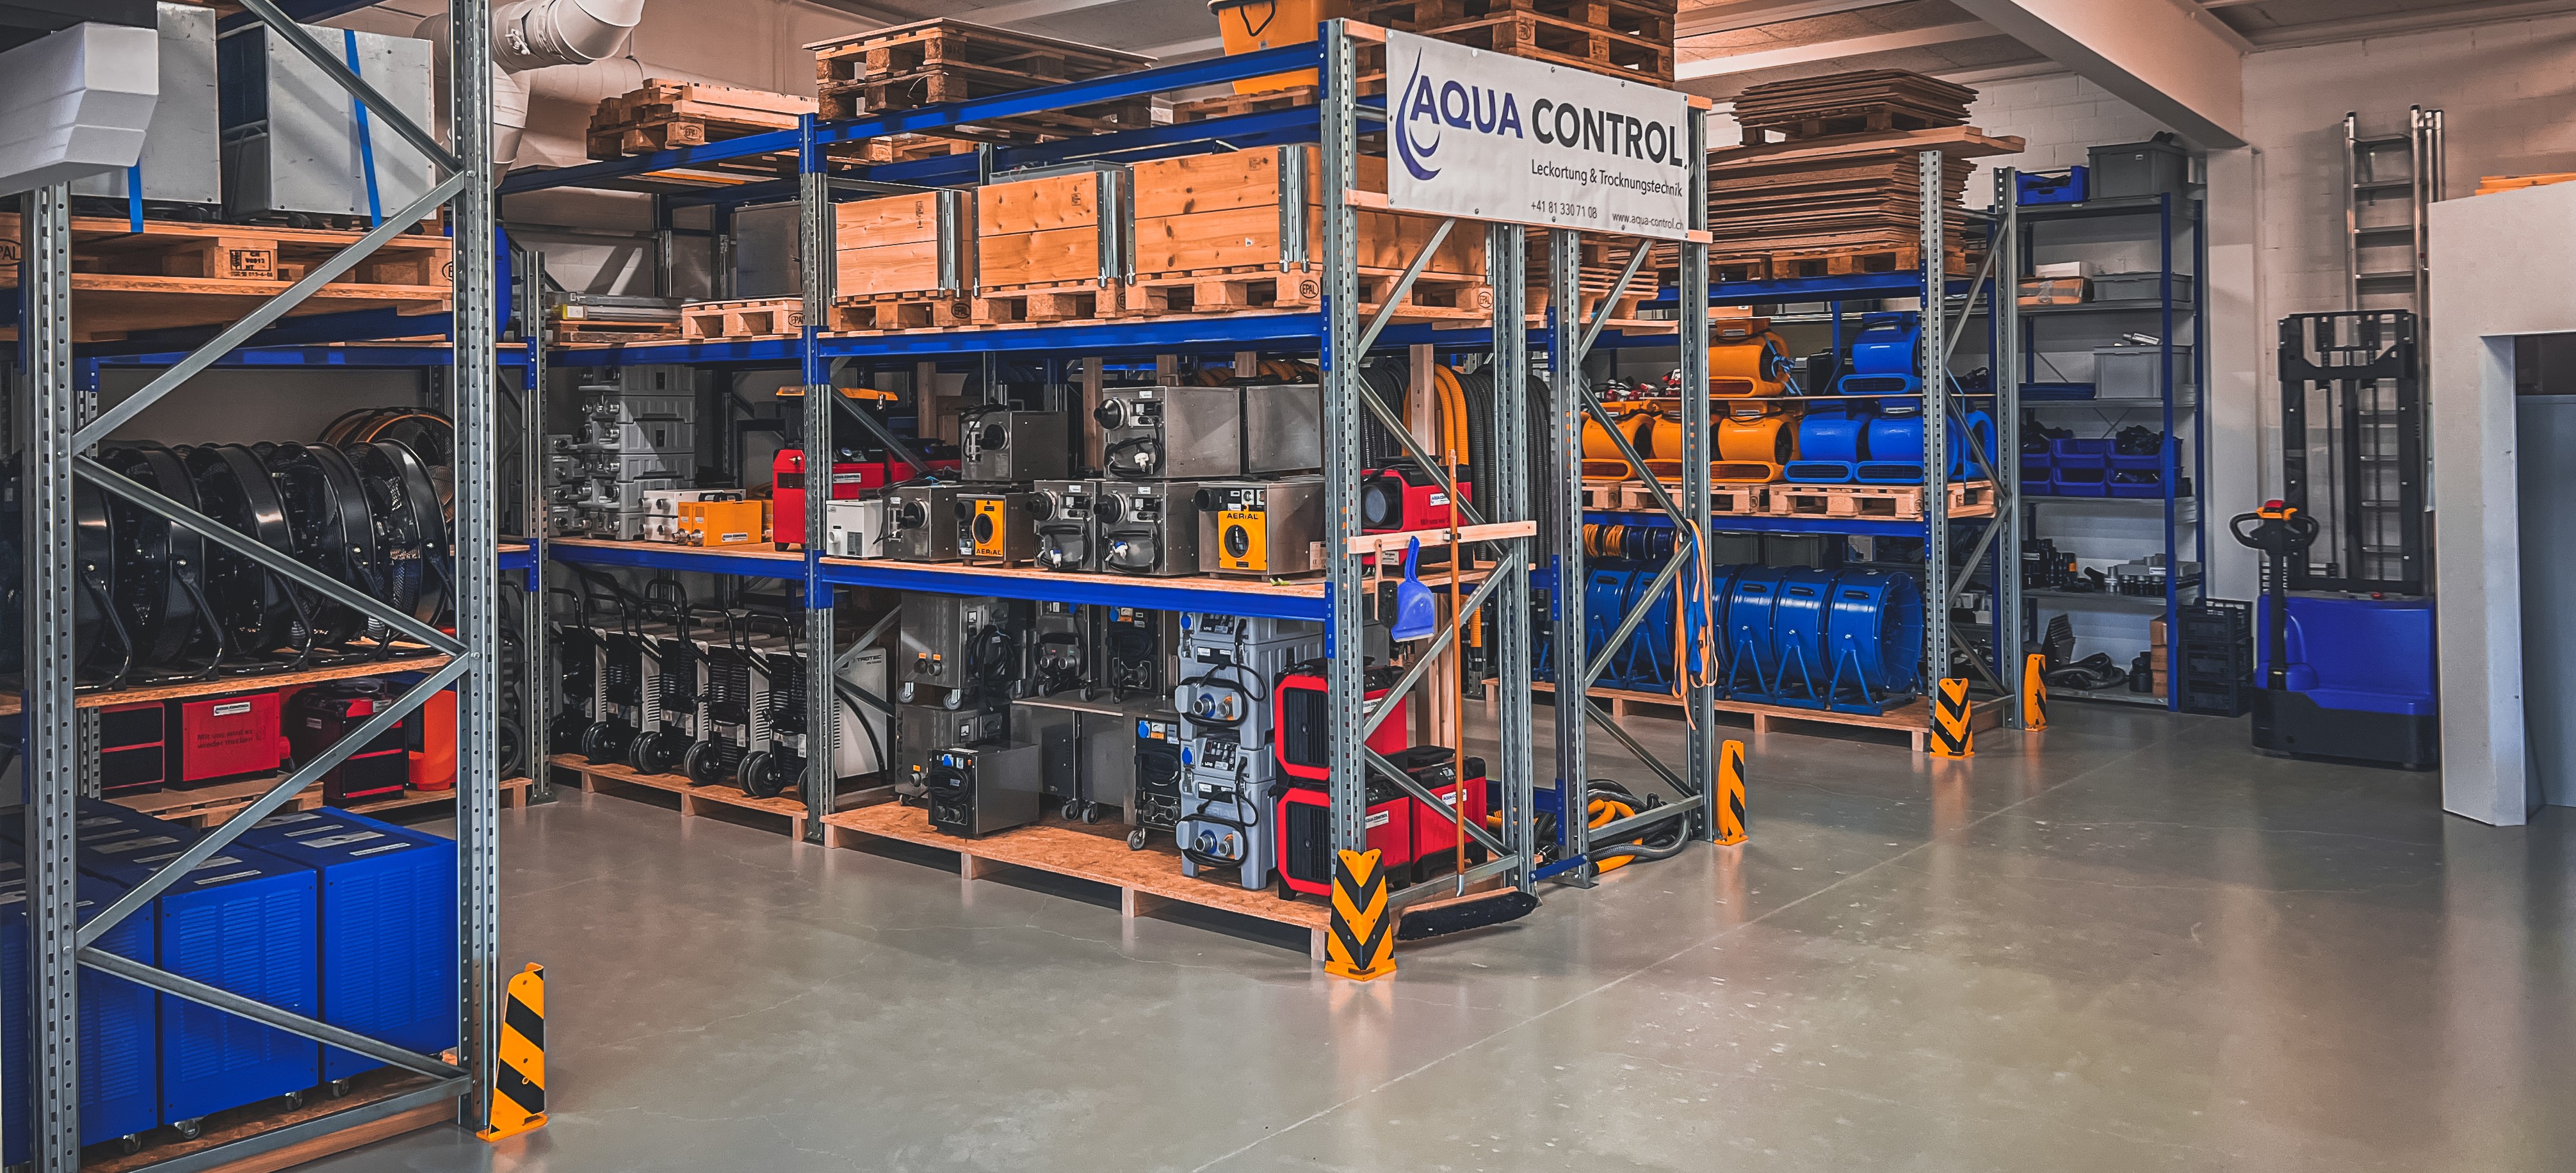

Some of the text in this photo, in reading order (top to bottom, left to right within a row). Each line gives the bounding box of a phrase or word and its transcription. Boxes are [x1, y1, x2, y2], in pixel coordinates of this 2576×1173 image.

[1410, 75, 1683, 167] AQUA CONTROL
[1532, 159, 1683, 197] Leckortung & Trocknungstechnik
[1531, 200, 1598, 219] +41 81 330 71 08
[1612, 213, 1684, 231] www.aqua-control.ch
[1302, 284, 1316, 295] EPAL
